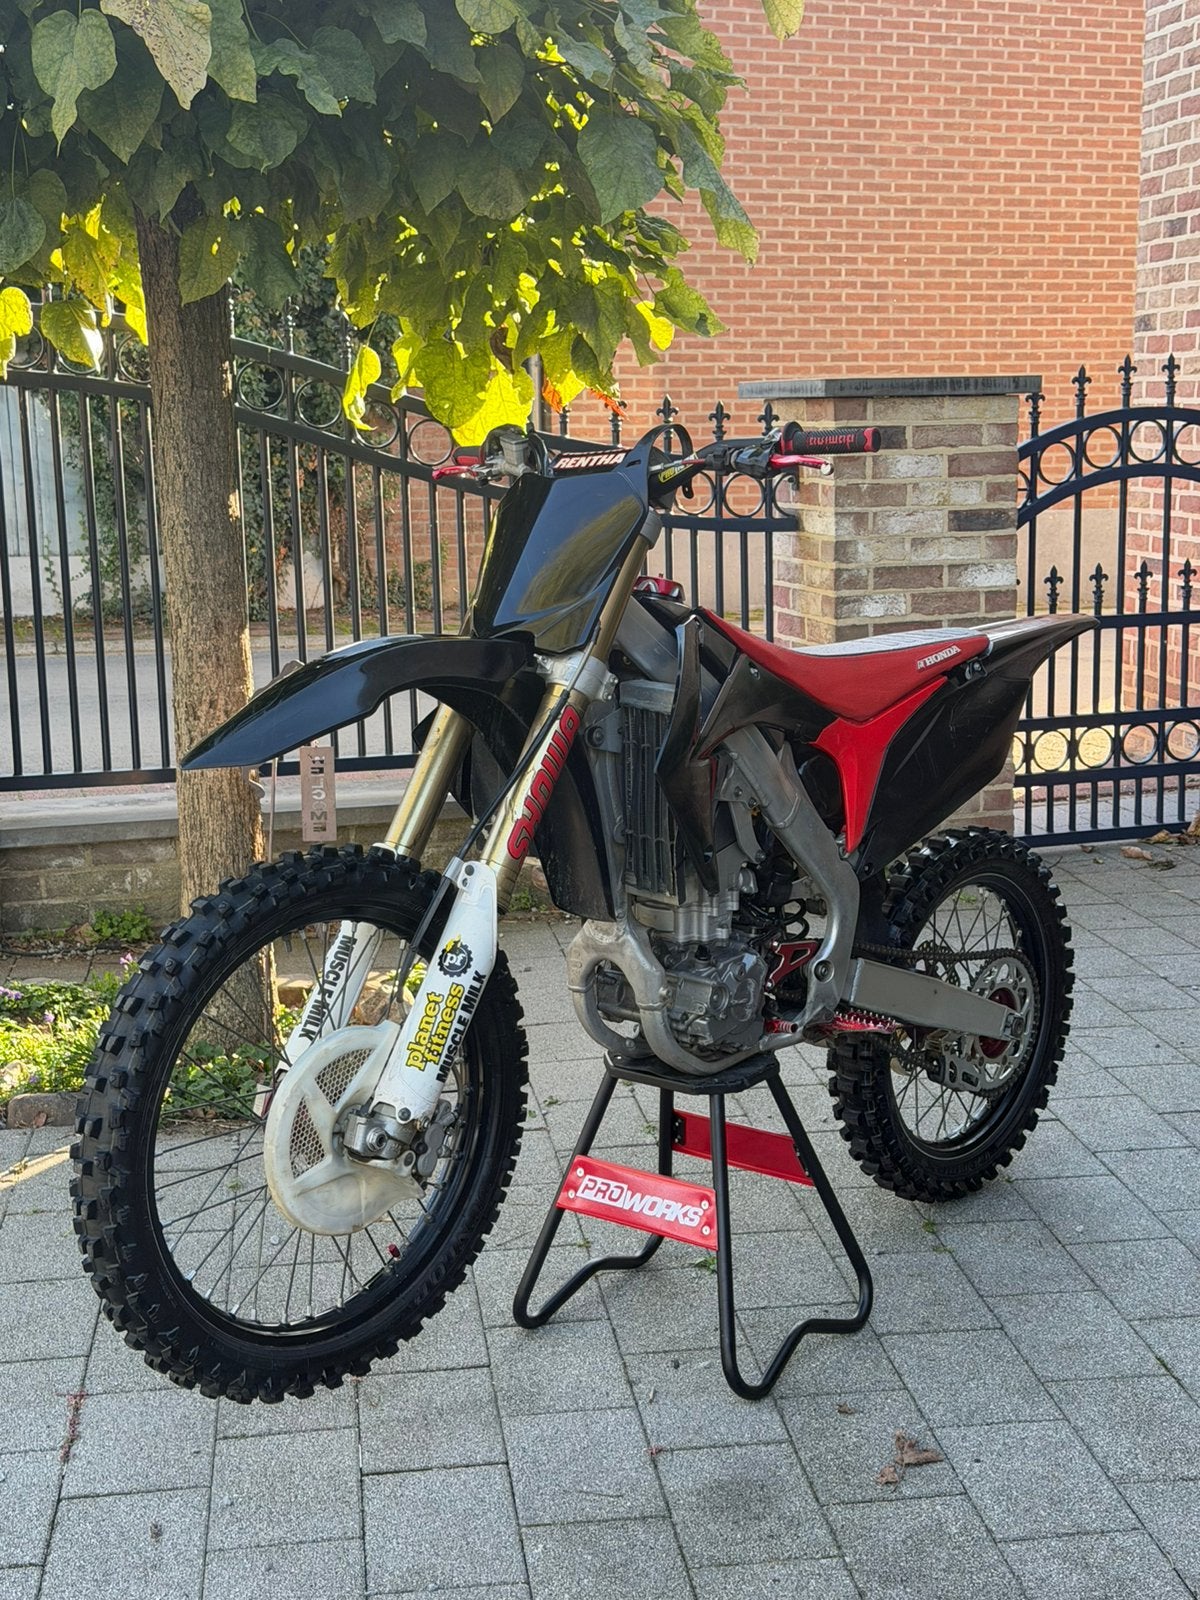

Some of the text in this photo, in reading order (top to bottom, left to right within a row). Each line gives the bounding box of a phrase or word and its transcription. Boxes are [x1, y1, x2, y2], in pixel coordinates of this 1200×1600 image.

[553, 452, 626, 469] RENTHA
[926, 645, 961, 667] HONDA
[298, 935, 358, 1042] MUSCLE MILK
[426, 982, 464, 1065] fitness
[436, 970, 487, 1083] MUSCLE MILK
[406, 992, 443, 1072] planet
